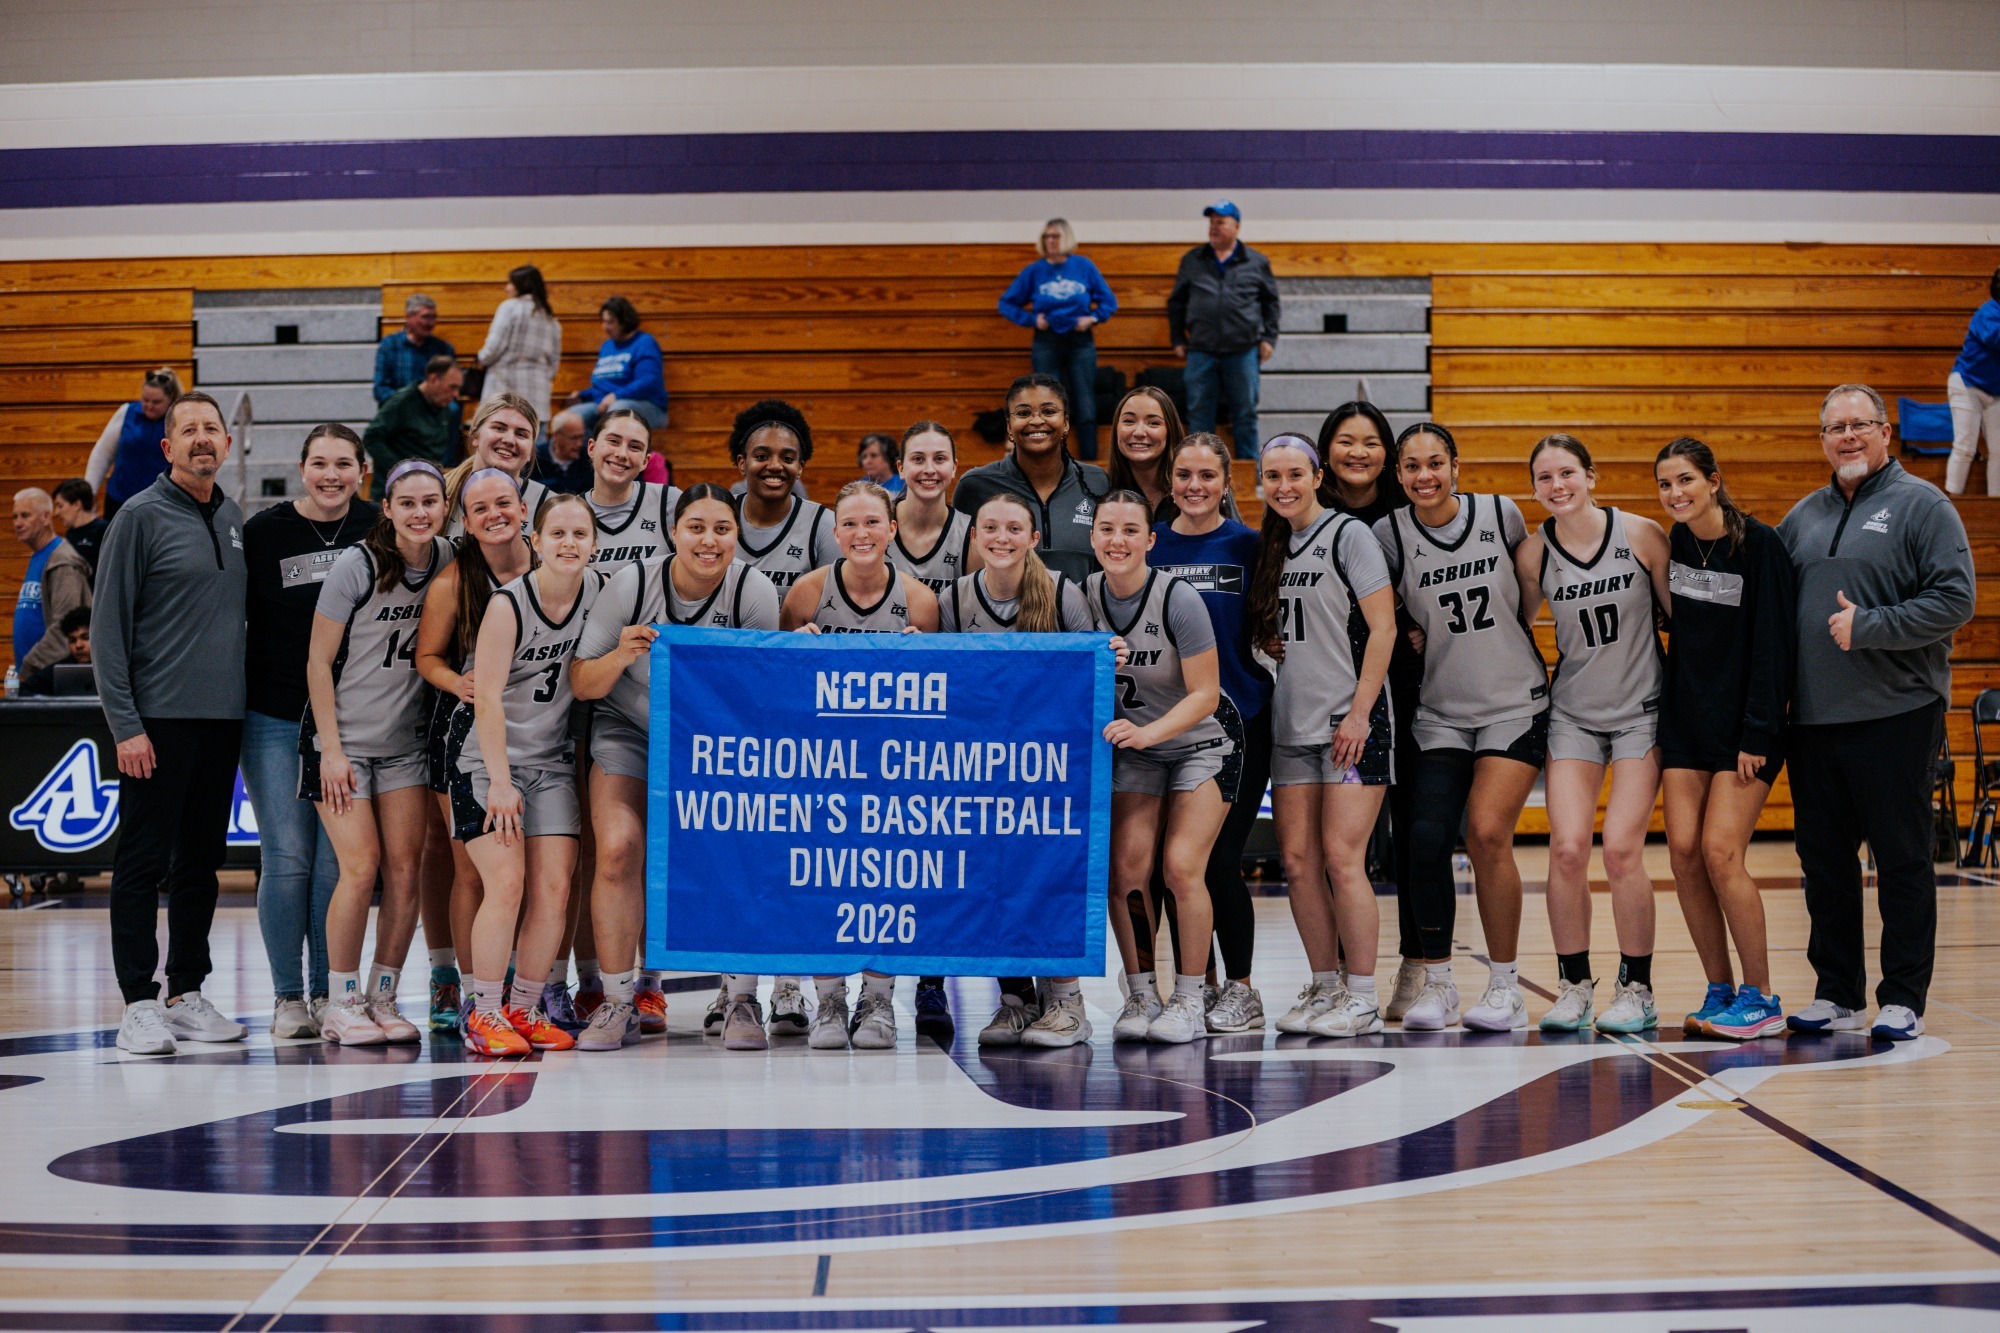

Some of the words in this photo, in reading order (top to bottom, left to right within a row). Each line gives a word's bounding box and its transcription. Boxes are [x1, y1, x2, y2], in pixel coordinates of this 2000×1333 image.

[641, 520, 656, 531] CCS
[1480, 530, 1495, 542] CCS
[588, 546, 657, 563] SBURY
[787, 546, 803, 557] CCS
[944, 553, 958, 565] CCS
[1312, 547, 1327, 557] CCS
[1615, 548, 1631, 559] CCS
[1280, 572, 1325, 588] BURY
[1418, 555, 1500, 589] ASBURY
[1553, 572, 1636, 601] ASBURY
[891, 604, 907, 616] CCS
[1438, 585, 1496, 634] 32
[713, 613, 729, 625] CCS
[1578, 603, 1619, 648] 10
[1145, 623, 1159, 635] CCS
[518, 638, 581, 661] ASBU
[534, 662, 562, 702] 3
[816, 671, 947, 712] NCCAA
[692, 735, 868, 779] REGIONAL
[880, 740, 1068, 783] CHAMPION
[676, 791, 847, 833] WOMEN'S
[862, 795, 1081, 835] BASKETBALL
[790, 848, 944, 889] DIVISION
[958, 850, 966, 889] I
[836, 903, 916, 944] 2026
[1743, 1009, 1767, 1023] HOKA
